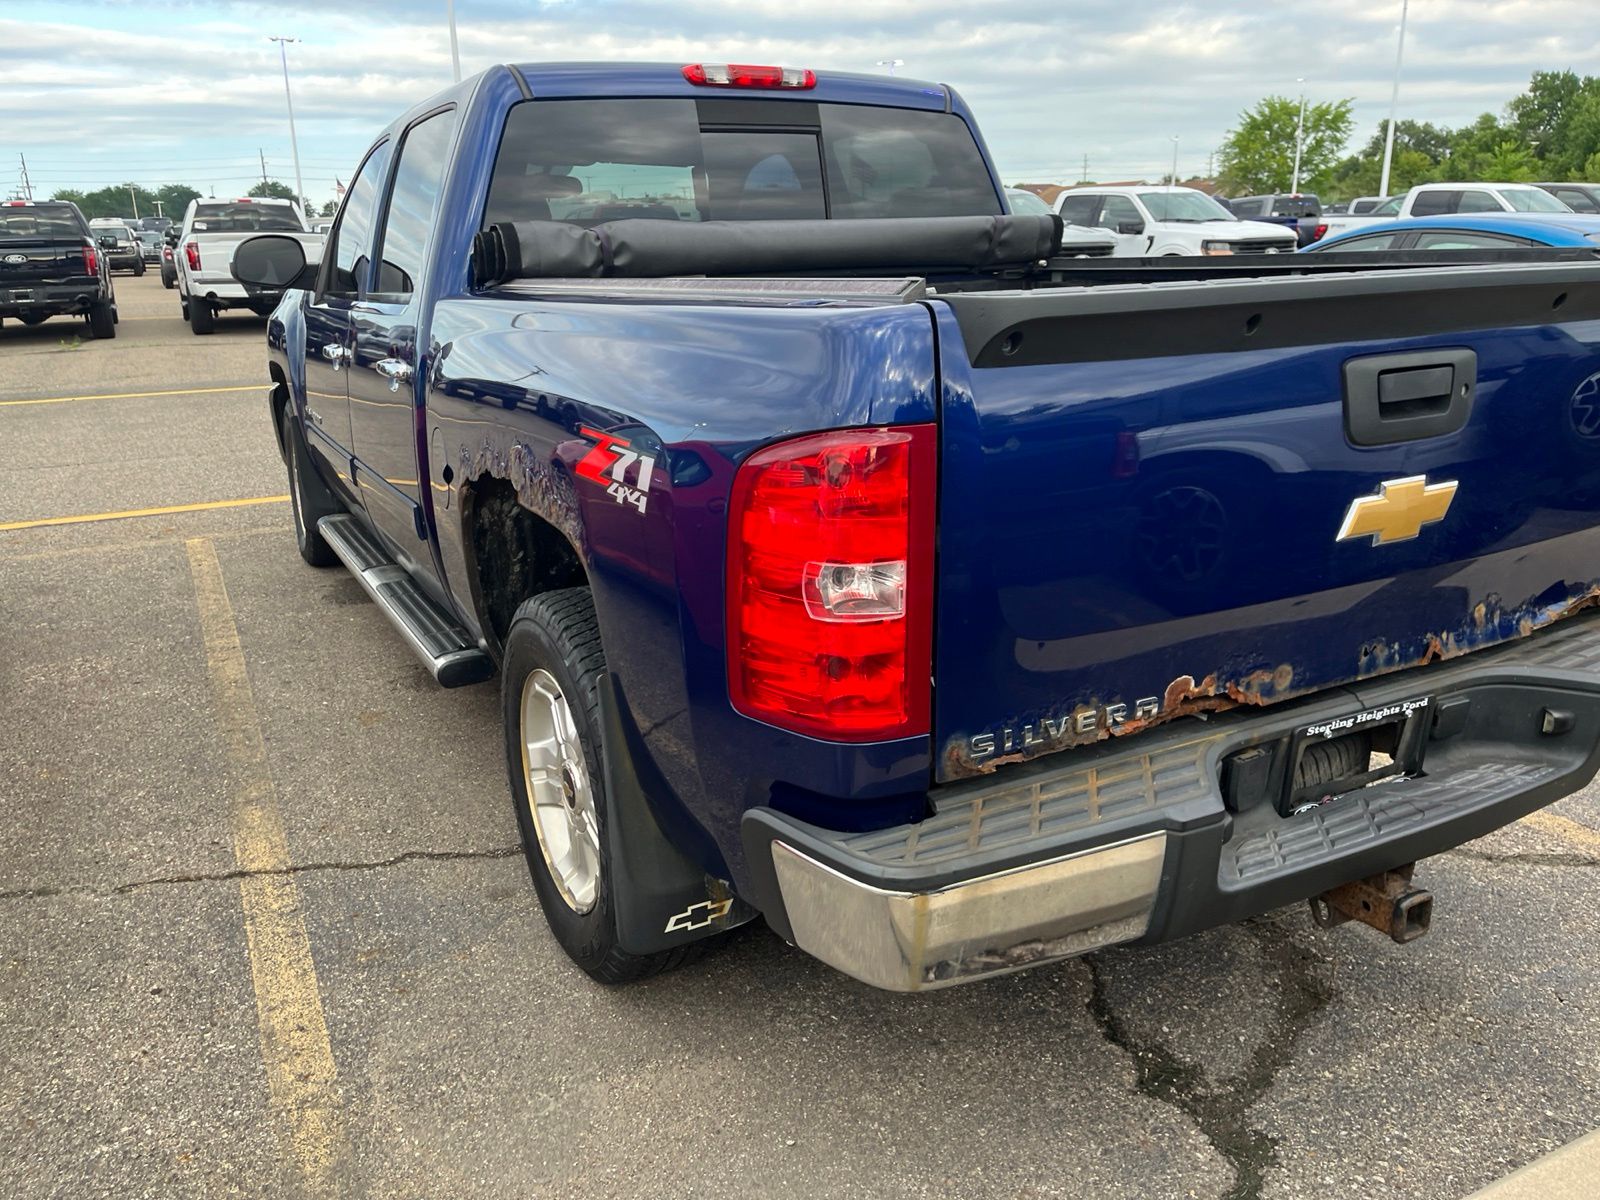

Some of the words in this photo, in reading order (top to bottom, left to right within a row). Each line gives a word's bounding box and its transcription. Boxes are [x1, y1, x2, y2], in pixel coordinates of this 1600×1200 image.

[576, 427, 655, 493] Z71
[970, 695, 1159, 758] SILVERA
[1306, 718, 1354, 736] Sterling
[1355, 706, 1400, 724] Heights
[1401, 697, 1429, 712] Ford
